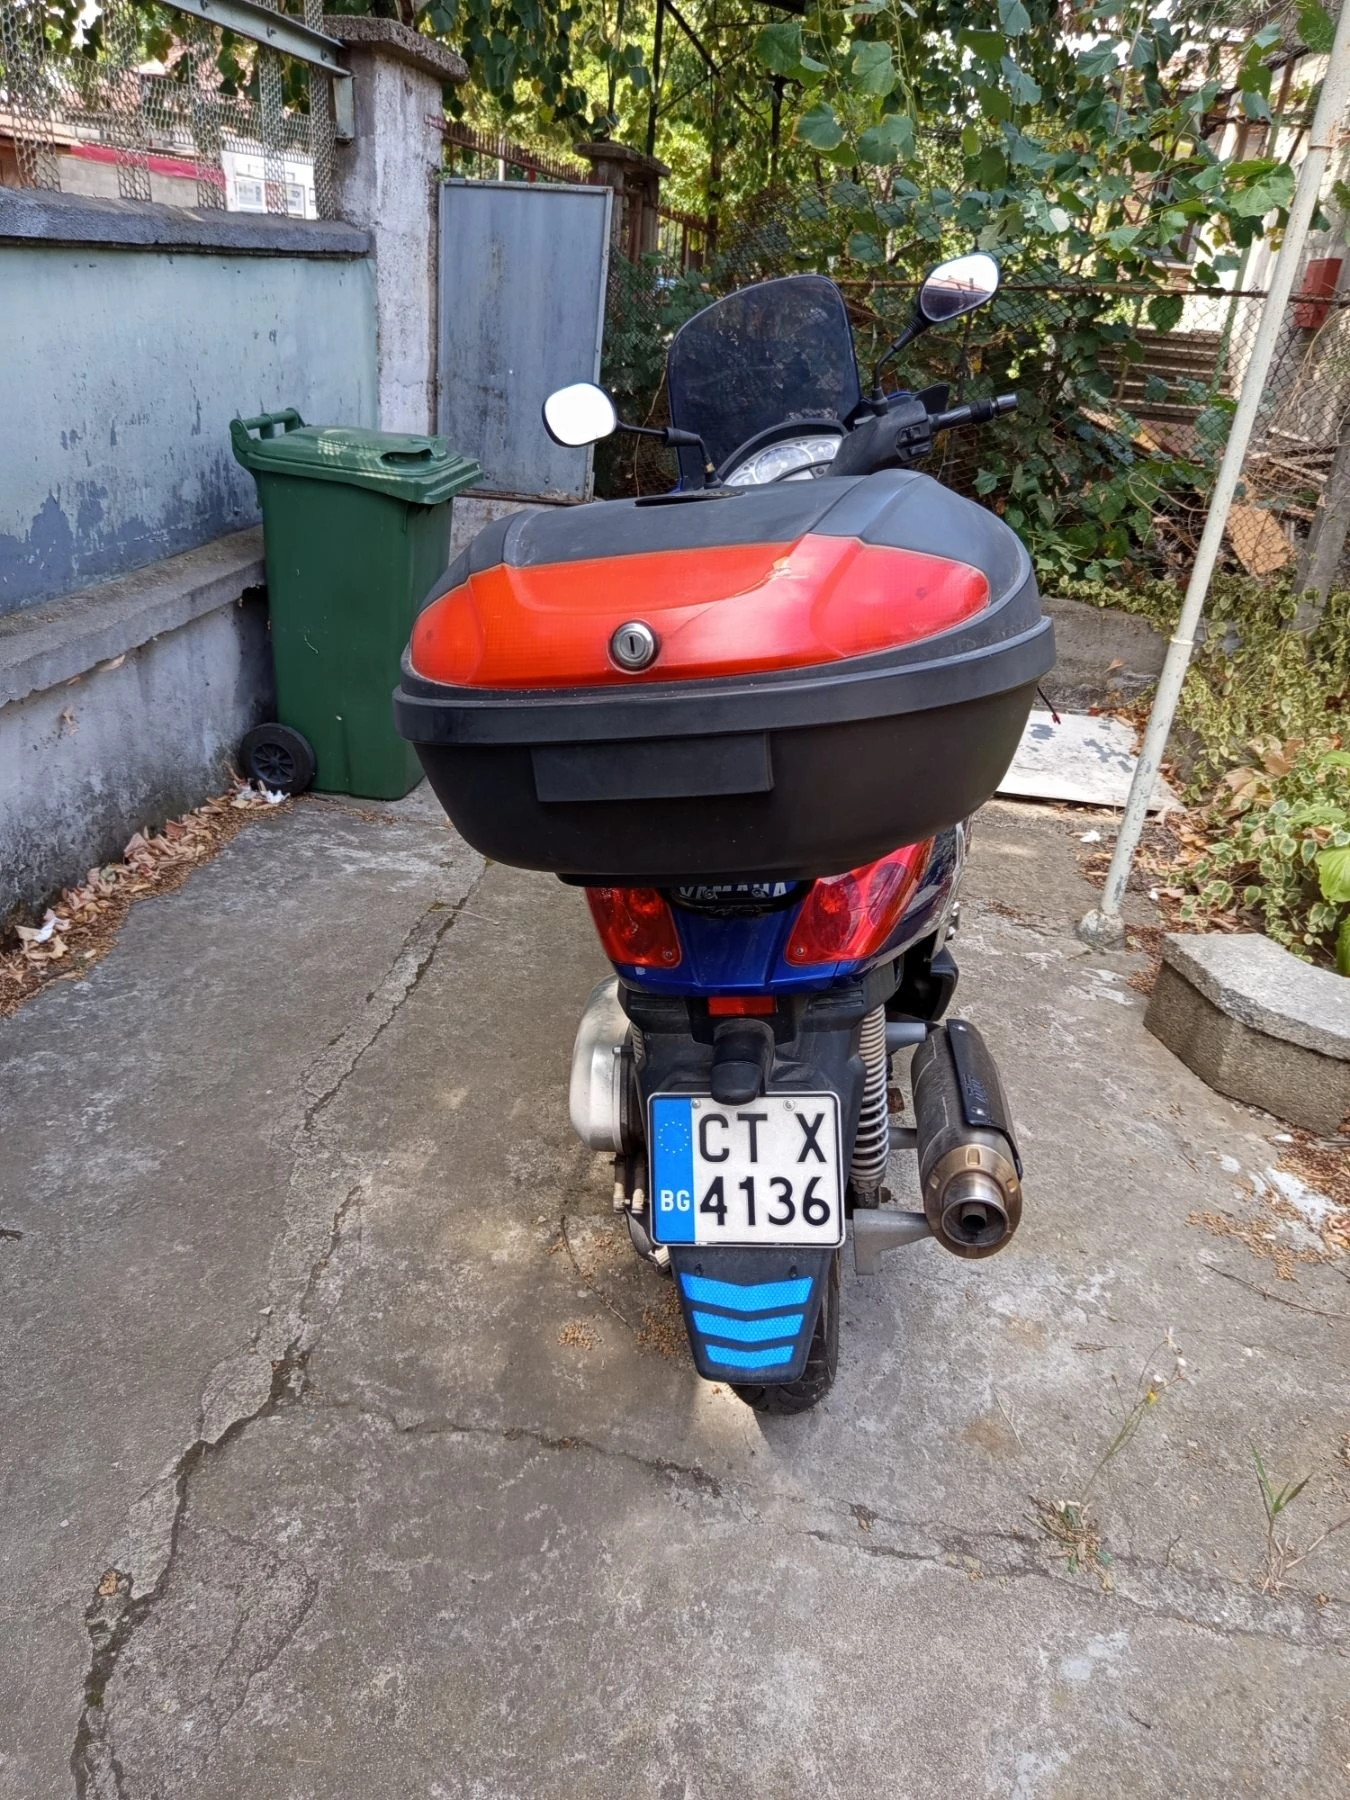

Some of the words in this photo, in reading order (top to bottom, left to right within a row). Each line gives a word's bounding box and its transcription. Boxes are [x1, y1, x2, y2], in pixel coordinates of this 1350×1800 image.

[679, 882, 787, 899] YAHA
[699, 1113, 768, 1163] CT
[796, 1113, 827, 1163] X
[660, 1190, 690, 1212] BG
[700, 1176, 830, 1226] 4136
